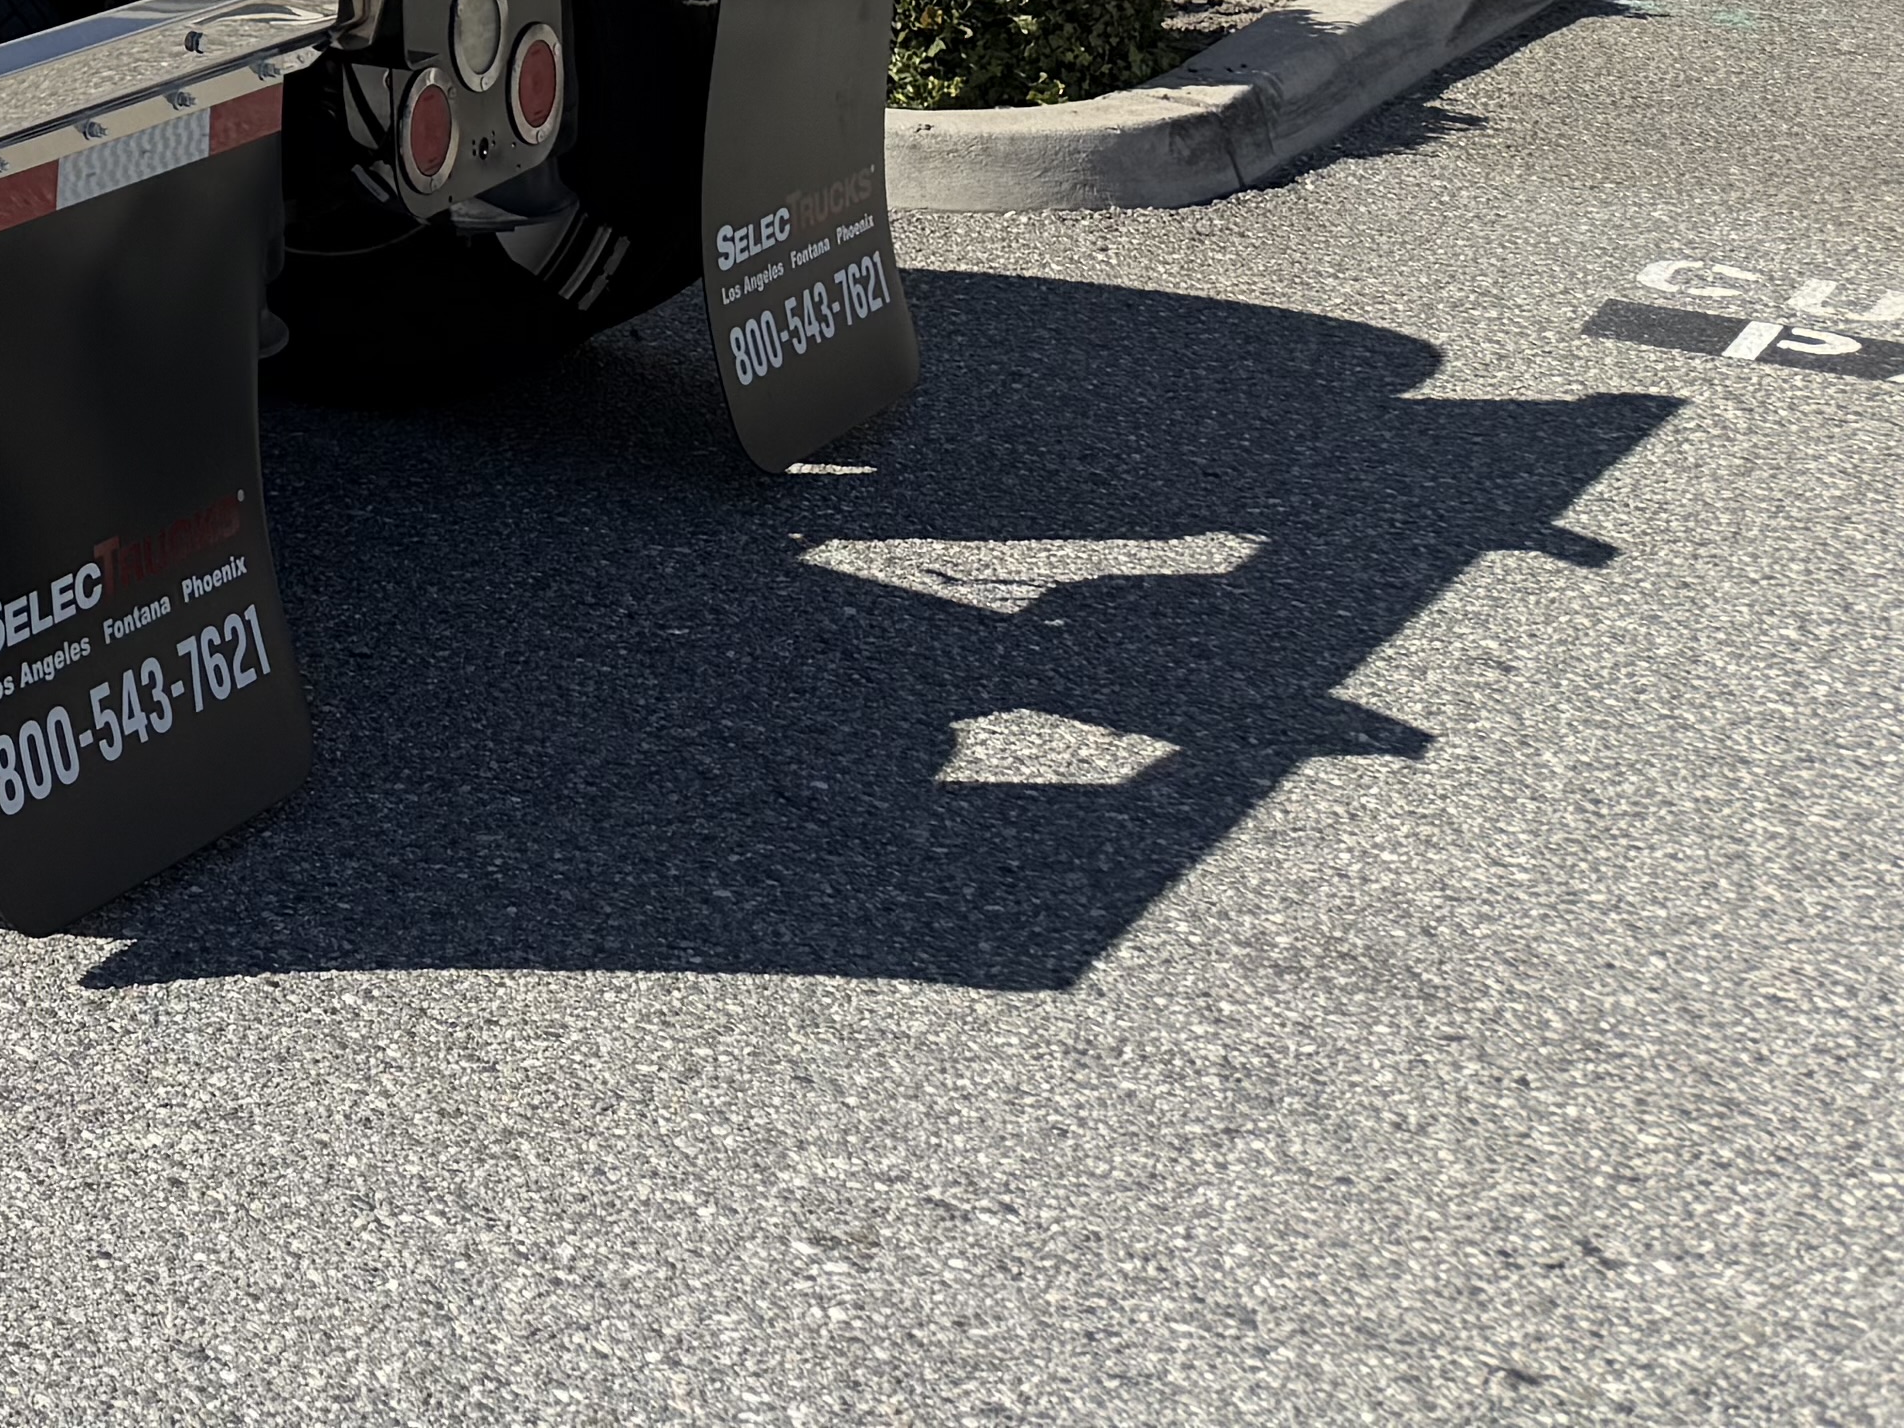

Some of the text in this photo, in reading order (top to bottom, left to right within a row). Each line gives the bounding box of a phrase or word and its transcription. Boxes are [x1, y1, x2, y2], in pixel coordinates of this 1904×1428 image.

[722, 213, 875, 305] Los Angeles Fontana Phoenix
[729, 250, 891, 386] 800-543-7621
[20, 634, 91, 688] Angeles
[102, 595, 172, 644] Fontana
[181, 555, 248, 604] Phoenix
